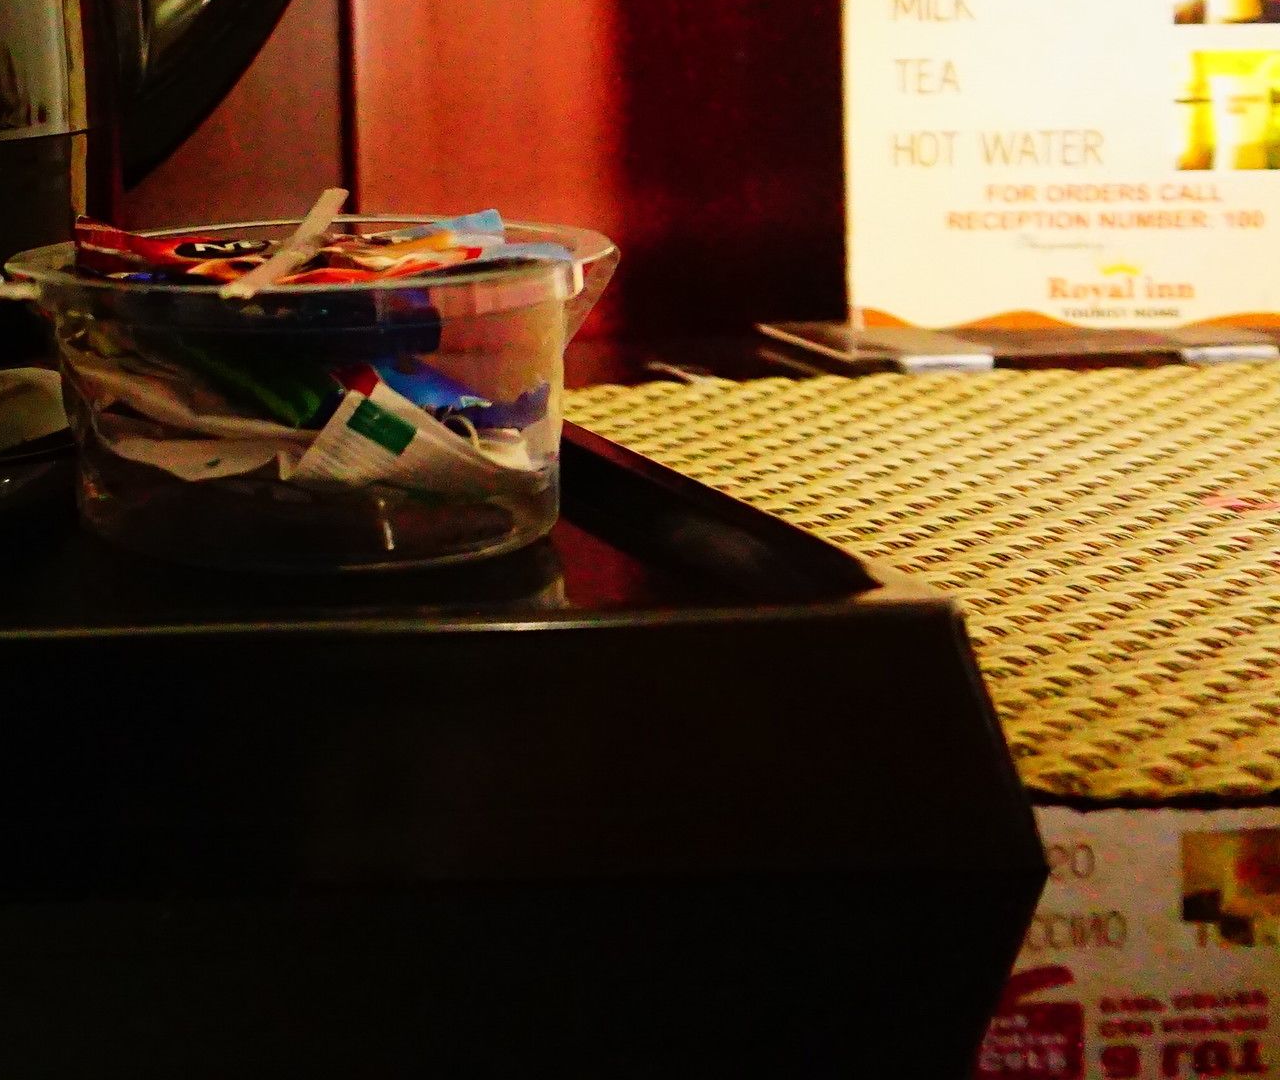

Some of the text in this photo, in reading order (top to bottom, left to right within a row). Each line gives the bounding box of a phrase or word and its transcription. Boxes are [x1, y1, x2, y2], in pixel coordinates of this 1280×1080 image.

[894, 58, 961, 94] TEA
[893, 129, 1105, 167] HOT WATER
[986, 182, 1224, 202] FOR ORDERS CALL
[947, 209, 1089, 231] RECEPTION
[1048, 276, 1135, 301] Royal
